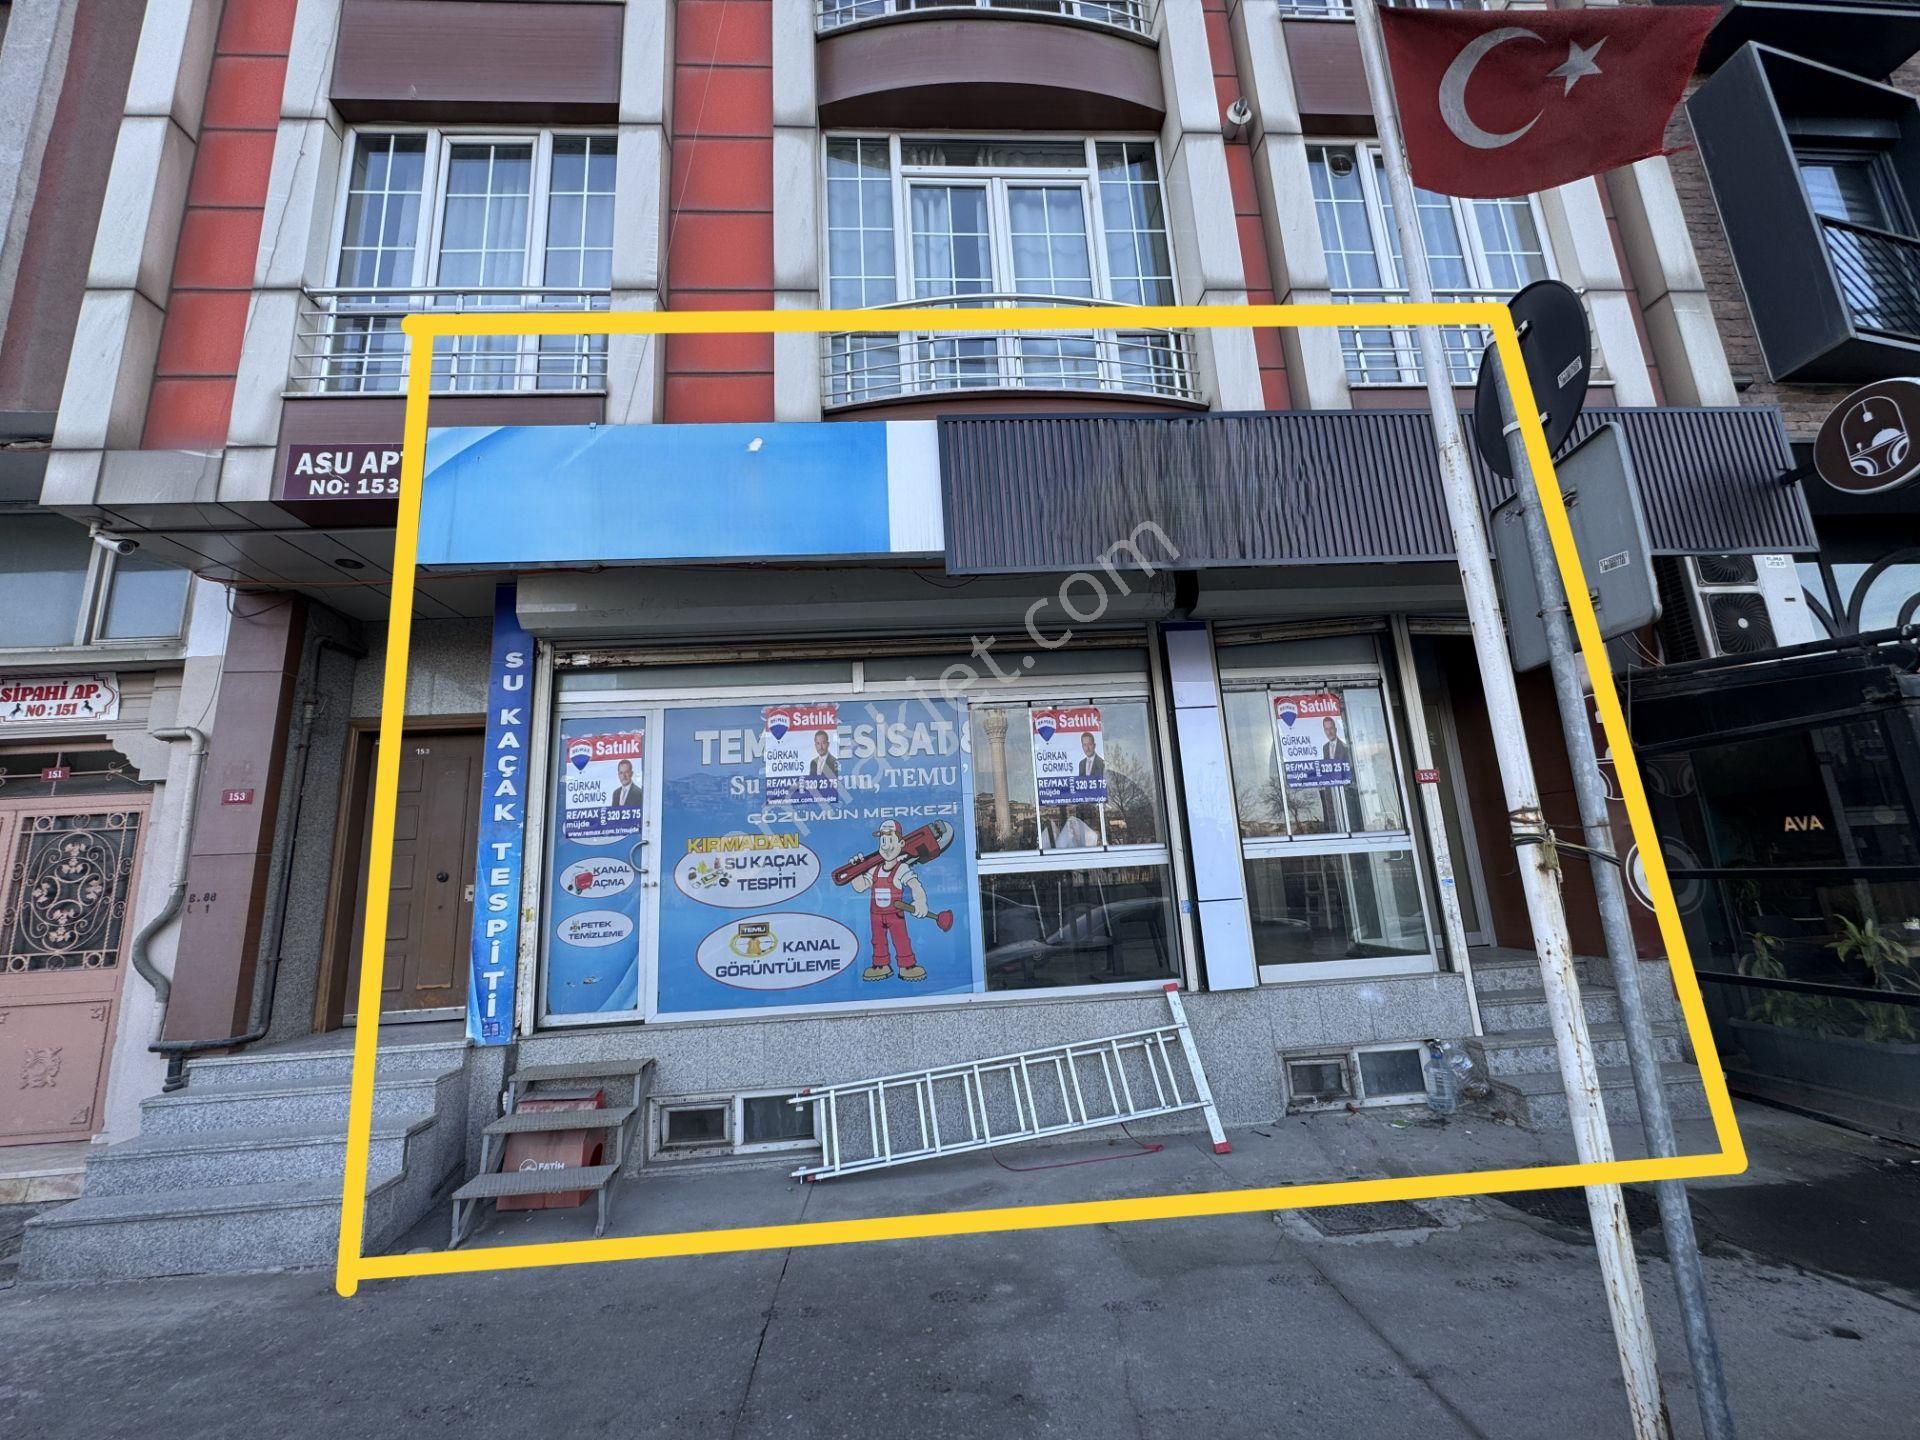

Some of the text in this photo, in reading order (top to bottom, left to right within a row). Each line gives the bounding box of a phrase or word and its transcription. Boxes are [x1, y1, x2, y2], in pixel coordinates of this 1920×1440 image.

[294, 451, 404, 475] ASU AP
[309, 478, 399, 495] NO: 153
[502, 652, 524, 691] SU
[0, 681, 101, 703] SİPAHİ AP.
[55, 703, 78, 716] 151
[1299, 699, 1338, 713] Satılık
[792, 711, 835, 726] Satılık
[1058, 713, 1100, 728] Satılık
[694, 730, 765, 765] TEM
[837, 712, 953, 758] ESİSAT
[1282, 735, 1311, 746] GÜRKAN
[595, 740, 640, 756] Satılık
[767, 749, 799, 760] GÜRKAN
[1037, 750, 1067, 761] GÜRKAN
[494, 708, 522, 822] KAÇAK
[1042, 761, 1074, 773] GÖRMÜŞ
[1285, 762, 1314, 772] RE/MAX
[1321, 764, 1333, 773] 320
[1334, 763, 1342, 772] 25
[1343, 762, 1350, 771] 75
[48, 770, 62, 779] 151
[568, 780, 601, 791] GÜRKAN
[730, 775, 760, 795] Su
[766, 778, 798, 788] RE/MAX
[805, 780, 818, 789] 320
[819, 779, 828, 789] 25
[829, 779, 838, 788] 75
[1038, 778, 1069, 788] RE/MAX
[1075, 780, 1088, 790] 320
[1089, 780, 1097, 789] 25
[1098, 779, 1107, 789] 75
[228, 792, 246, 801] 153
[572, 791, 607, 804] GÖRMÜŞ
[566, 809, 599, 820] RE/MAX
[607, 811, 620, 821] 320
[621, 810, 630, 820] 25
[632, 809, 641, 819] 75
[747, 801, 958, 825] ÇÖZÜMÜN MERKEZİ
[1784, 815, 1825, 832] AVA
[687, 832, 800, 853] KIRMADAN
[725, 853, 809, 871] SU KAÇAK
[593, 866, 630, 875] KANAL
[592, 879, 625, 889] AÇMA
[737, 872, 796, 891] TESPİTİ
[580, 921, 612, 929] PETEK
[742, 926, 766, 934] TEMU
[568, 930, 623, 940] TEMİZLEME
[783, 939, 841, 953] KANAL
[715, 957, 841, 977] GÖRÜNTÜLEME
[538, 1161, 565, 1171] FATİH
